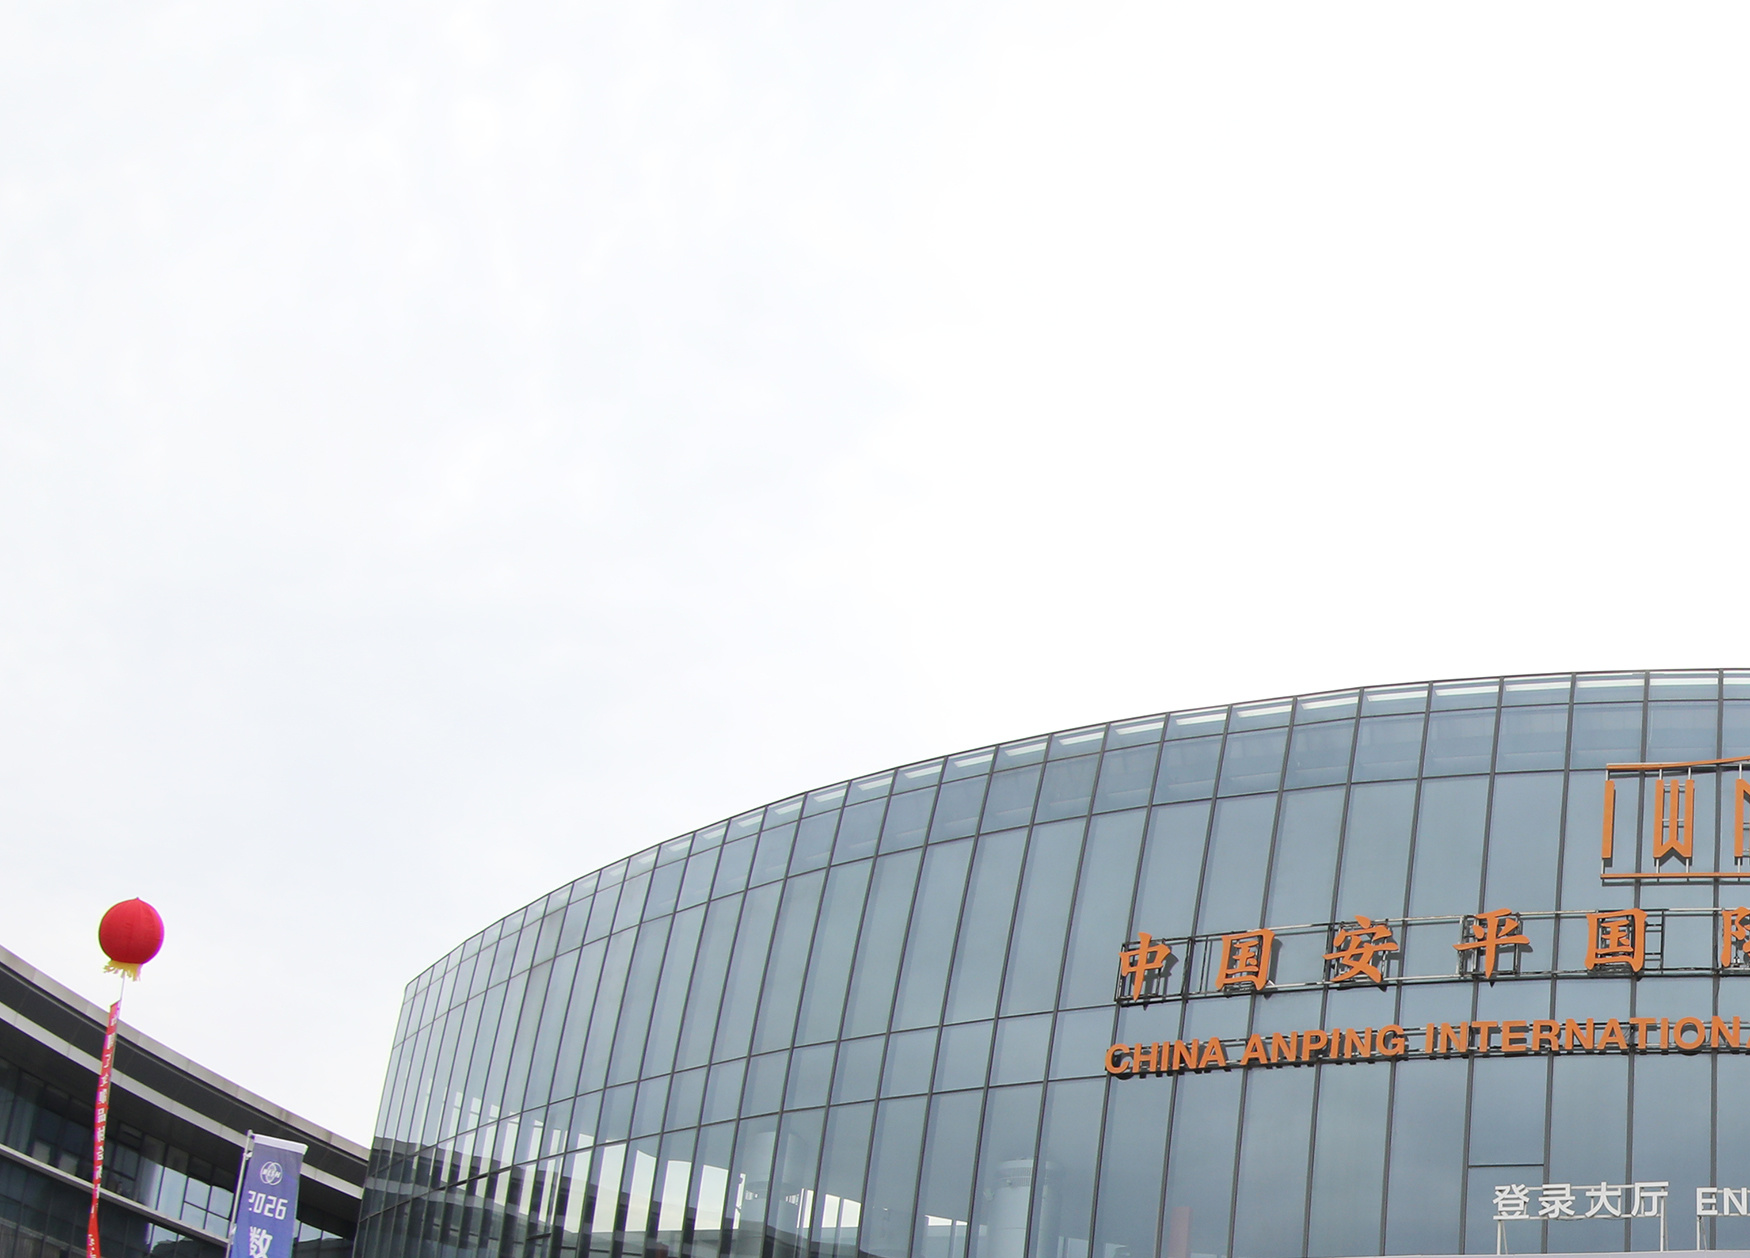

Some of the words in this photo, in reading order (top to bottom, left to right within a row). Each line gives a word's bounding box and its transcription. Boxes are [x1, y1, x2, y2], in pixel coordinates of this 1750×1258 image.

[1105, 1035, 1226, 1076] CHINA
[1241, 1024, 1406, 1068] ANPING
[248, 1190, 289, 1221] 2026
[1493, 1182, 1669, 1219] 登录大厅
